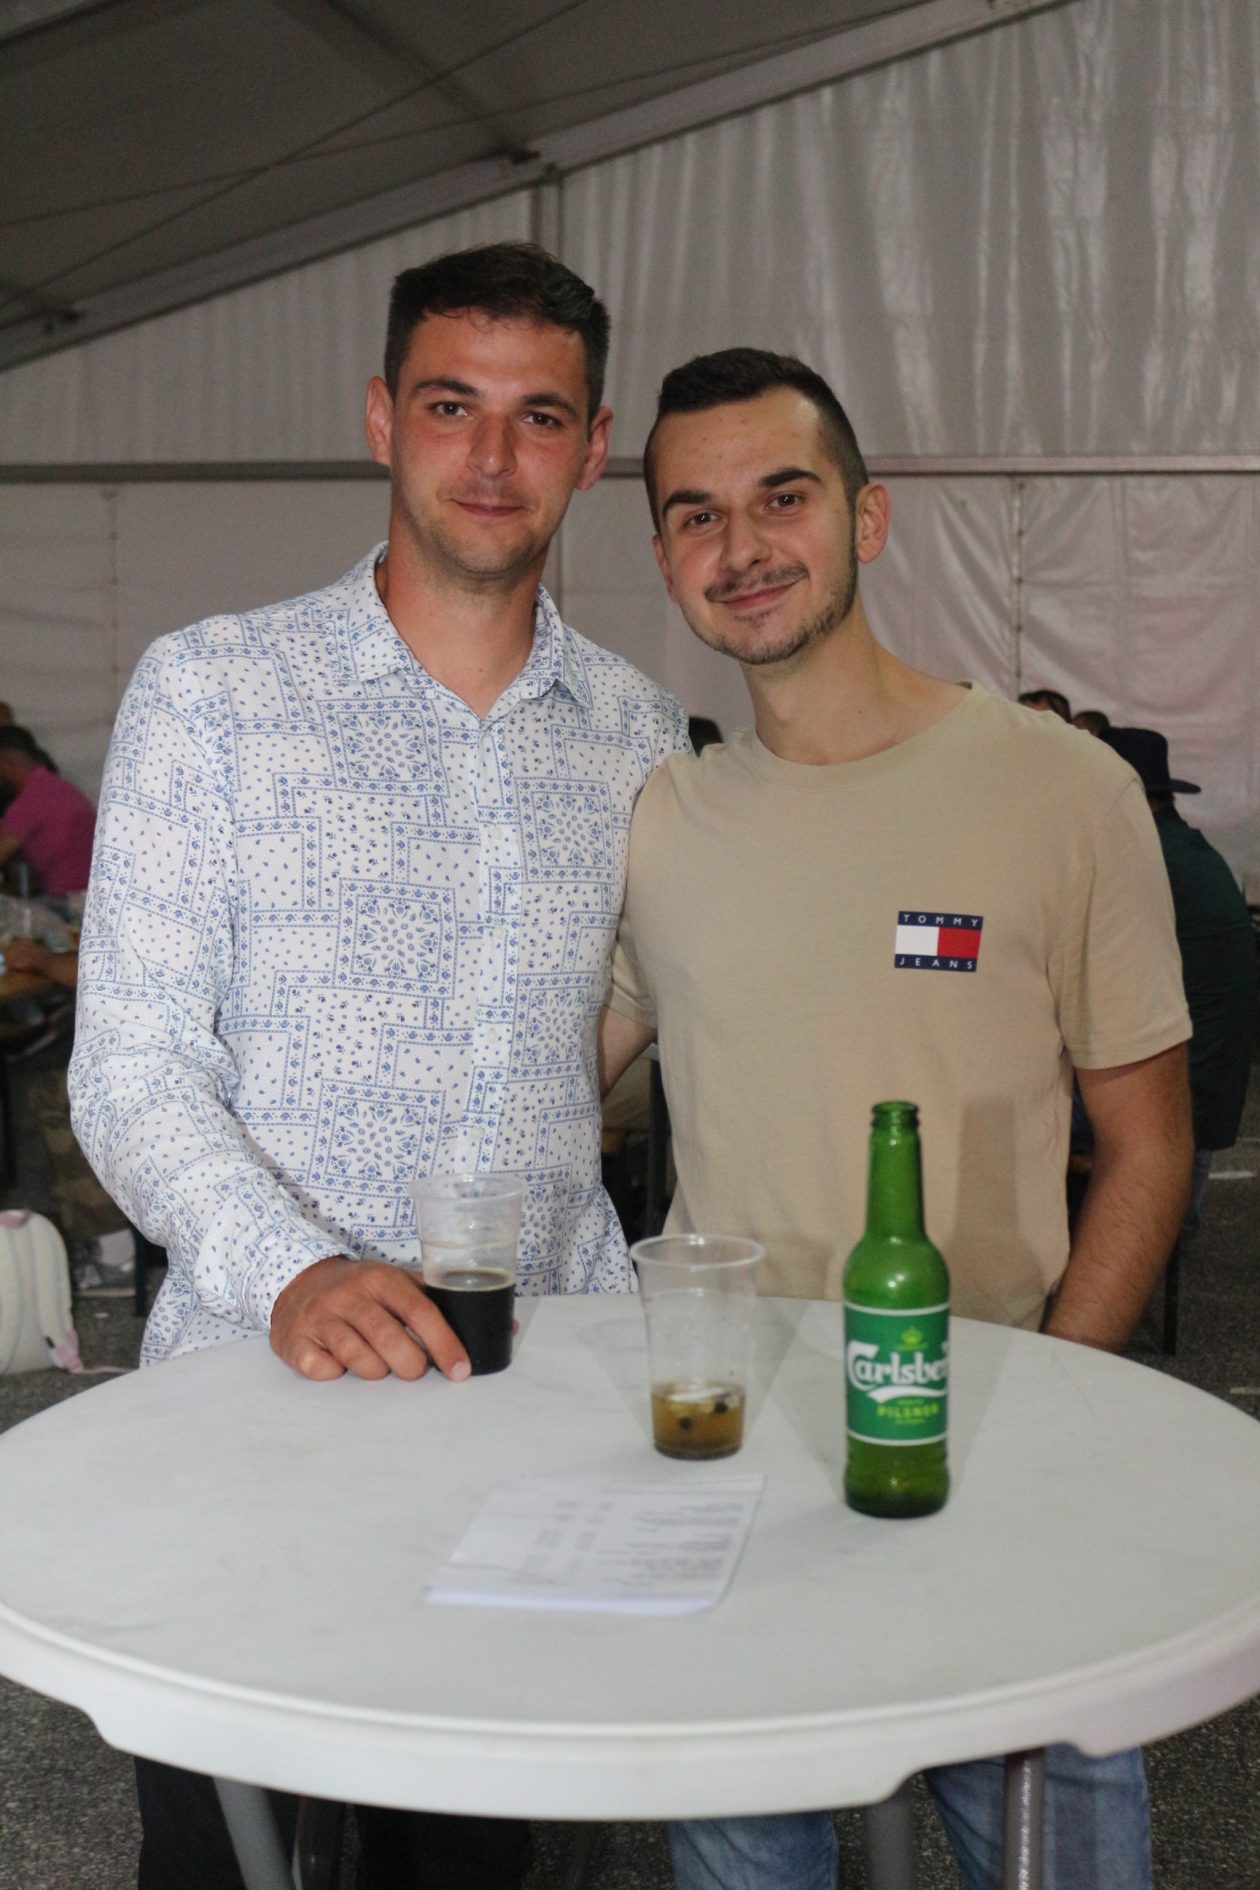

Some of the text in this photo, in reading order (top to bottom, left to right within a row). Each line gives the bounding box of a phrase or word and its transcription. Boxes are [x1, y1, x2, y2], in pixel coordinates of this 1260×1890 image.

[903, 914, 978, 927] TOMMY
[899, 957, 973, 970] JEANS
[847, 1339, 949, 1391] Carlsbe
